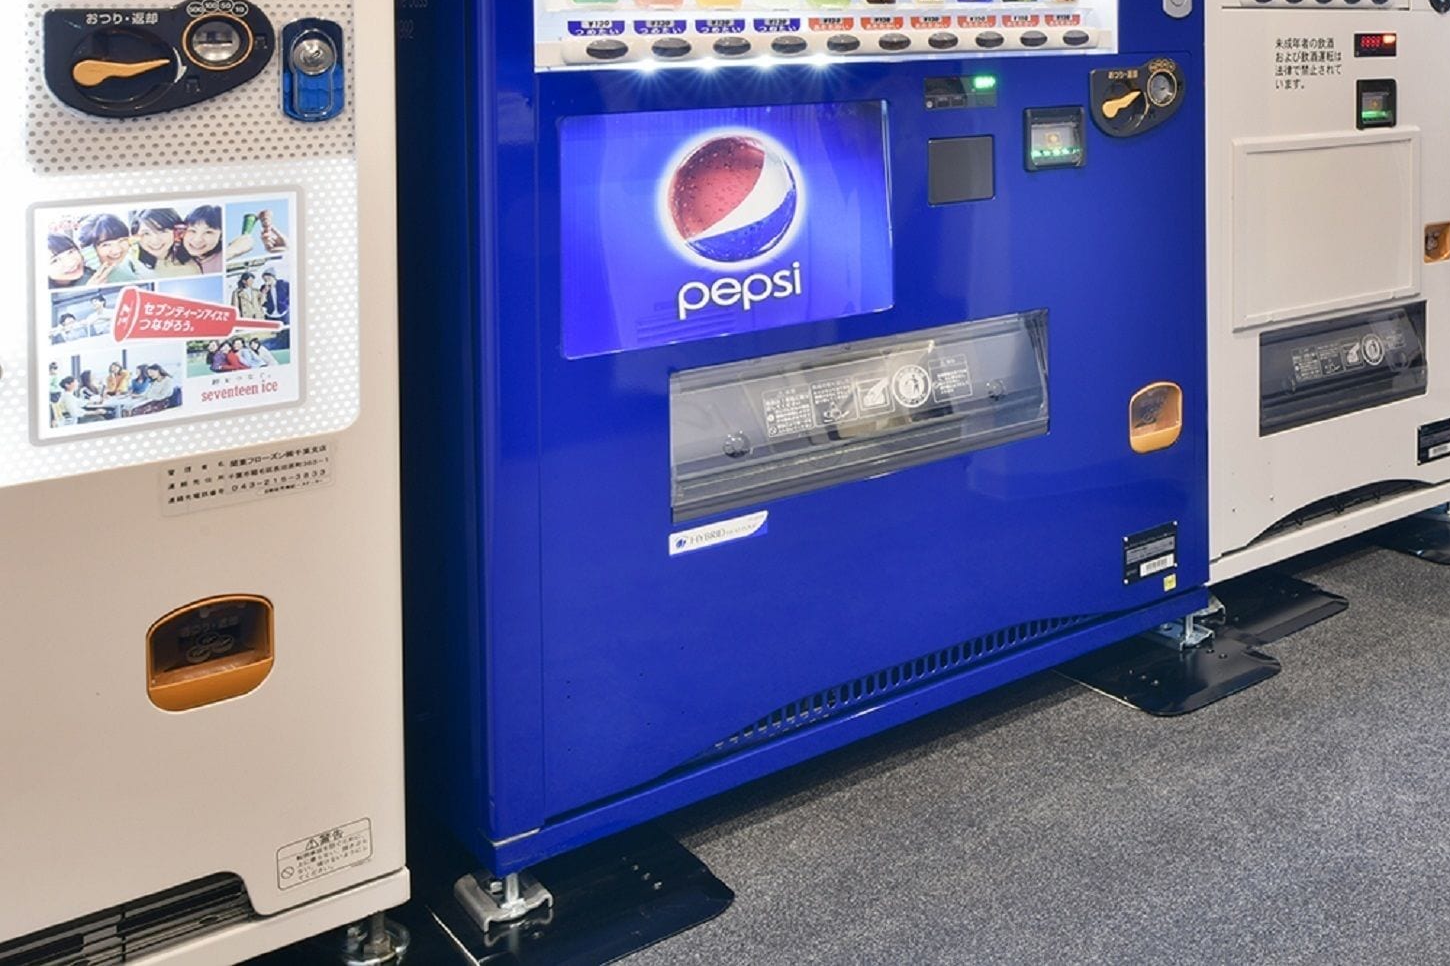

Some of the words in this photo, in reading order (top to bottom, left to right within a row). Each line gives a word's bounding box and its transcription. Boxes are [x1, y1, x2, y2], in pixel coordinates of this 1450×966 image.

[85, 12, 159, 26] おつり・返却
[1274, 37, 1335, 50] 未成年者の飲酒
[1274, 50, 1342, 63] および飲酒運転は
[1274, 64, 1343, 77] 法律で禁止されて
[1275, 79, 1306, 90] います。
[676, 261, 804, 321] pepsi
[143, 303, 231, 322] セブンティーンアイスで
[139, 319, 195, 333] つながろう。
[200, 383, 259, 402] seventeen
[261, 380, 279, 394] ice
